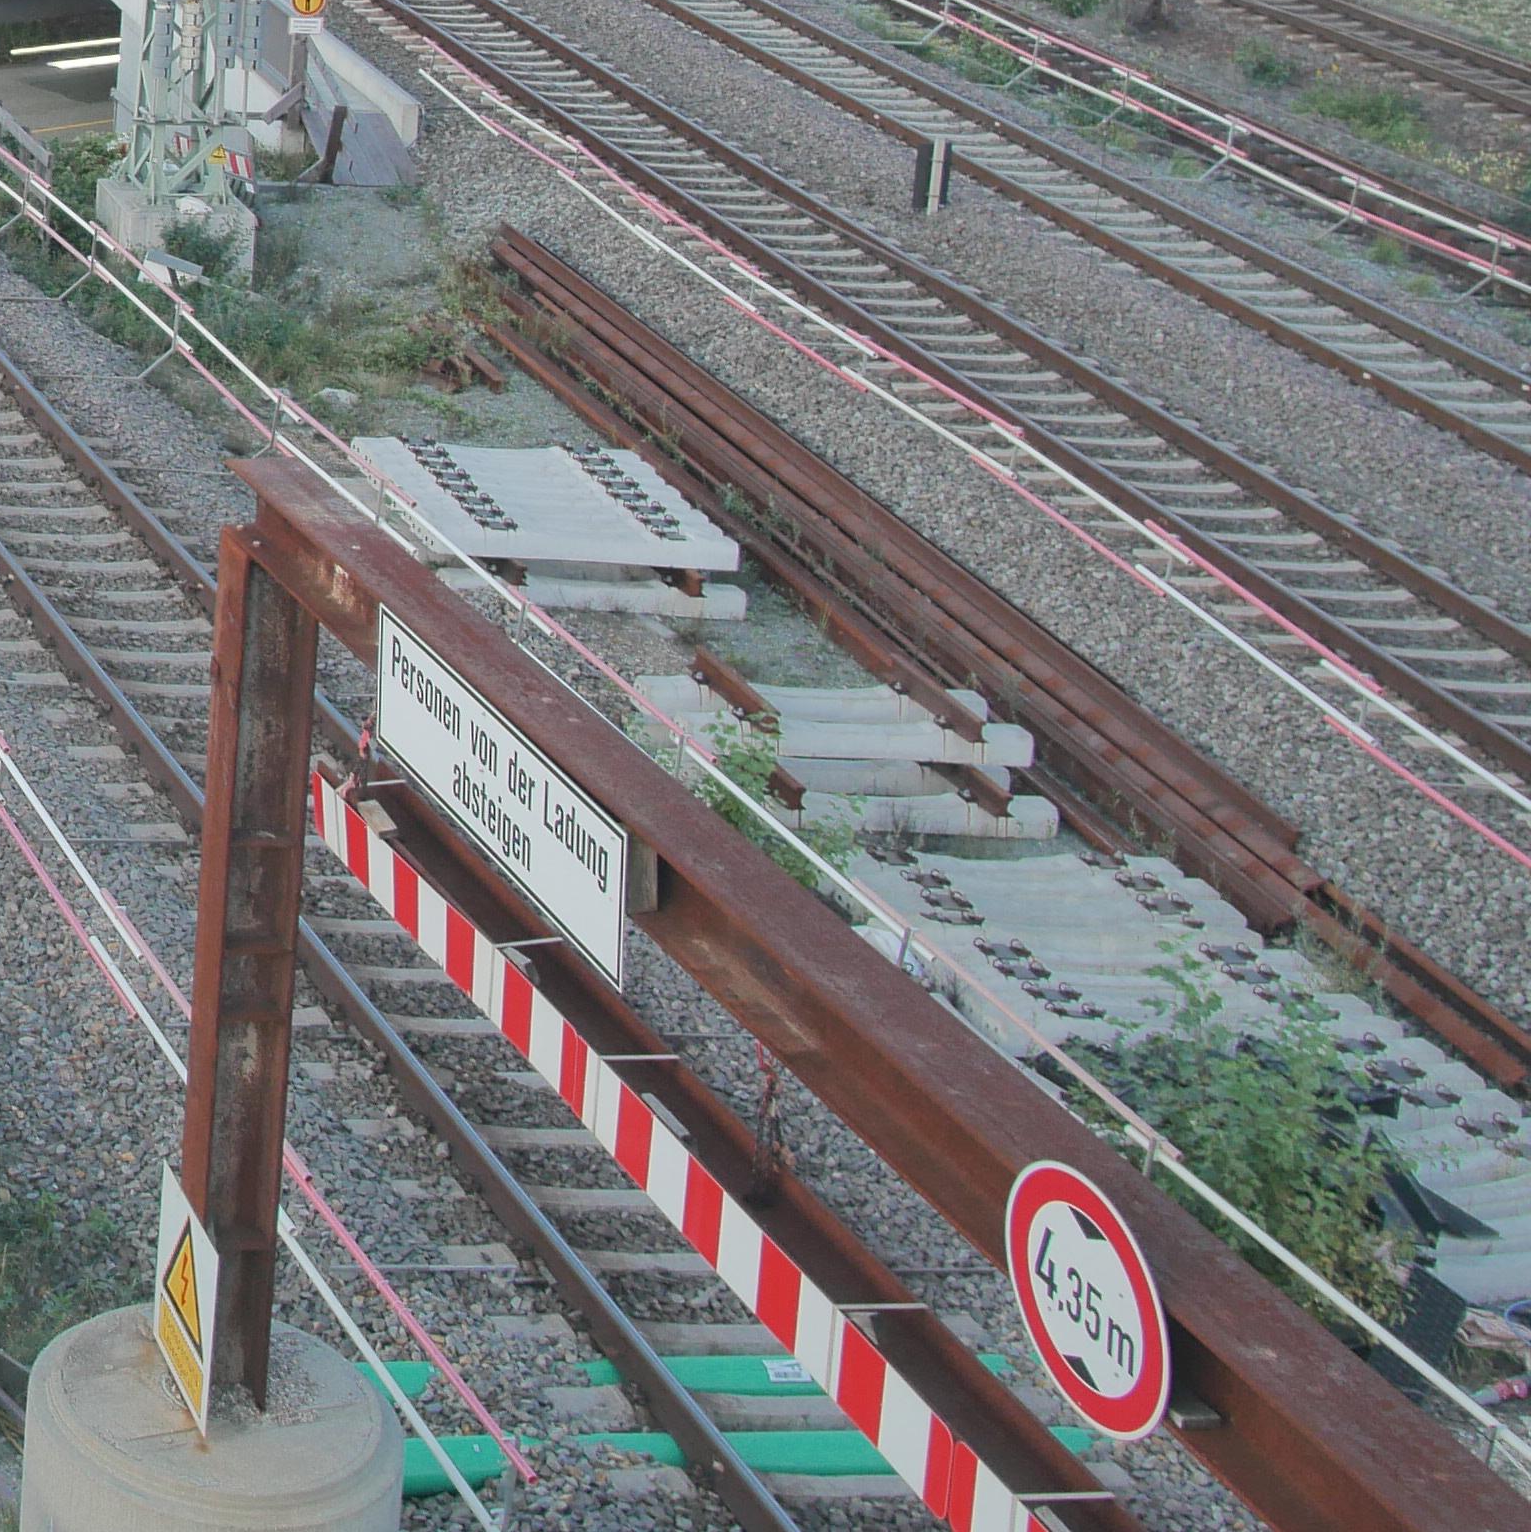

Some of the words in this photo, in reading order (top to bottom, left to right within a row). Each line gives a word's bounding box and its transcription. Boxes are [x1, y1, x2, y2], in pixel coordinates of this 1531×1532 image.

[391, 634, 461, 741] Personen
[470, 719, 498, 777] von
[508, 751, 536, 811] der
[543, 780, 609, 894] Ladung
[452, 761, 532, 873] absteigen
